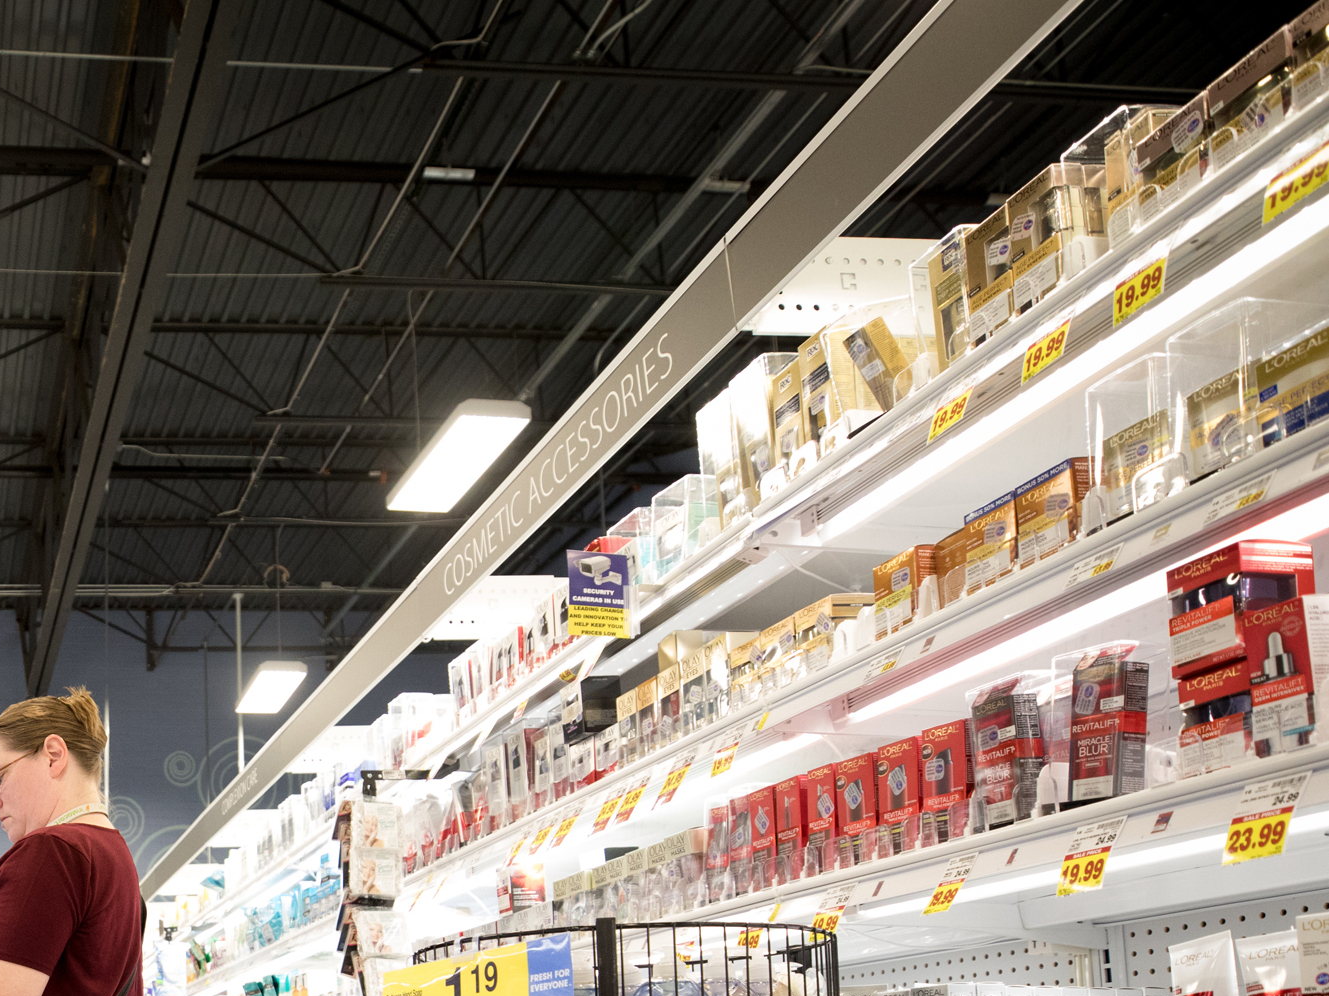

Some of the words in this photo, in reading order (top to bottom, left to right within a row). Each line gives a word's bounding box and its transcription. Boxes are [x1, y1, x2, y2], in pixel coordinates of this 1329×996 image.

[1270, 160, 1329, 209] 19.99
[1116, 265, 1163, 314] 19.99
[1026, 331, 1066, 373] 19.99
[932, 396, 967, 432] 19.99
[443, 490, 524, 595] COSMETIC
[528, 332, 673, 514] ACCESSORIES
[1191, 566, 1211, 578] PARIS
[572, 595, 603, 603] CAMERAS
[583, 588, 614, 596] SECURITY
[1172, 604, 1219, 627] REVITALIFT
[683, 658, 701, 675] OLAY
[1254, 678, 1304, 697] REVITALIFT
[1072, 719, 1119, 734] REVITALIFT
[1077, 735, 1110, 748] MIRACLE
[1079, 744, 1109, 757] BLUR
[986, 770, 1010, 784] BLUR
[928, 795, 959, 806] REVITALIFT
[1272, 792, 1299, 806] 24.99
[884, 808, 913, 819] REVITALIFT
[1243, 813, 1261, 822] SALE
[1262, 808, 1282, 818] PRICE
[666, 835, 685, 850] OLAY
[1095, 833, 1116, 846] 24.99
[1229, 820, 1285, 852] 23.99
[1072, 850, 1086, 859] SALE
[1086, 847, 1102, 857] PRICE
[1062, 858, 1104, 886] 19.99
[928, 886, 957, 907] 19.99
[471, 961, 498, 994] 19
[530, 972, 553, 983] FRESH
[554, 969, 570, 979] FOR
